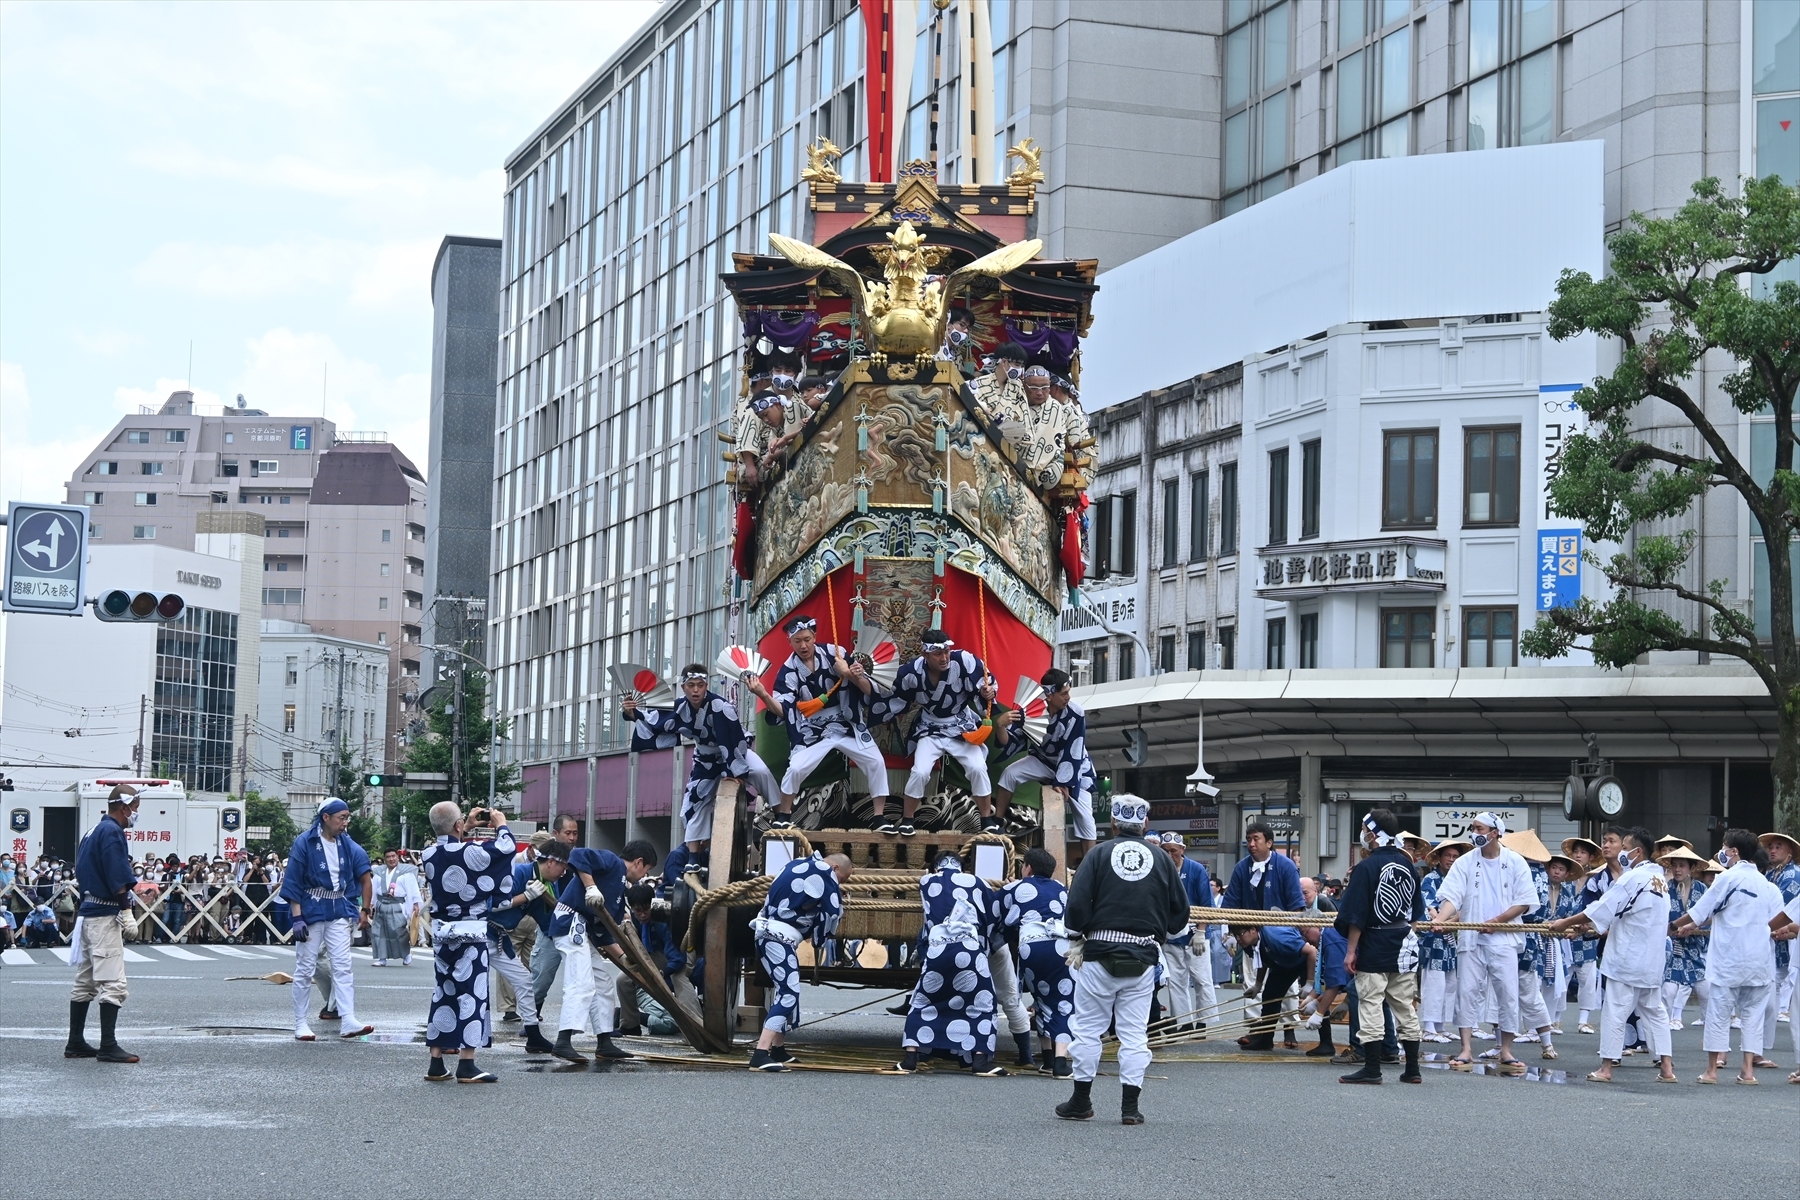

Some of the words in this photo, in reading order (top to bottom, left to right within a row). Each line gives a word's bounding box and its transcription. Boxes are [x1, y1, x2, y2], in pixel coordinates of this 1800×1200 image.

[1264, 550, 1397, 585] 池善化粧品店
[1561, 538, 1576, 574] すぐ
[176, 570, 199, 586] TAKU
[201, 575, 222, 589] SEED
[1541, 537, 1558, 608] 買えます
[13, 581, 76, 598] 路線バスを除く
[1112, 597, 1135, 623] 雲の茶
[1189, 820, 1204, 829] ACCESS
[1205, 819, 1219, 828] TICKET
